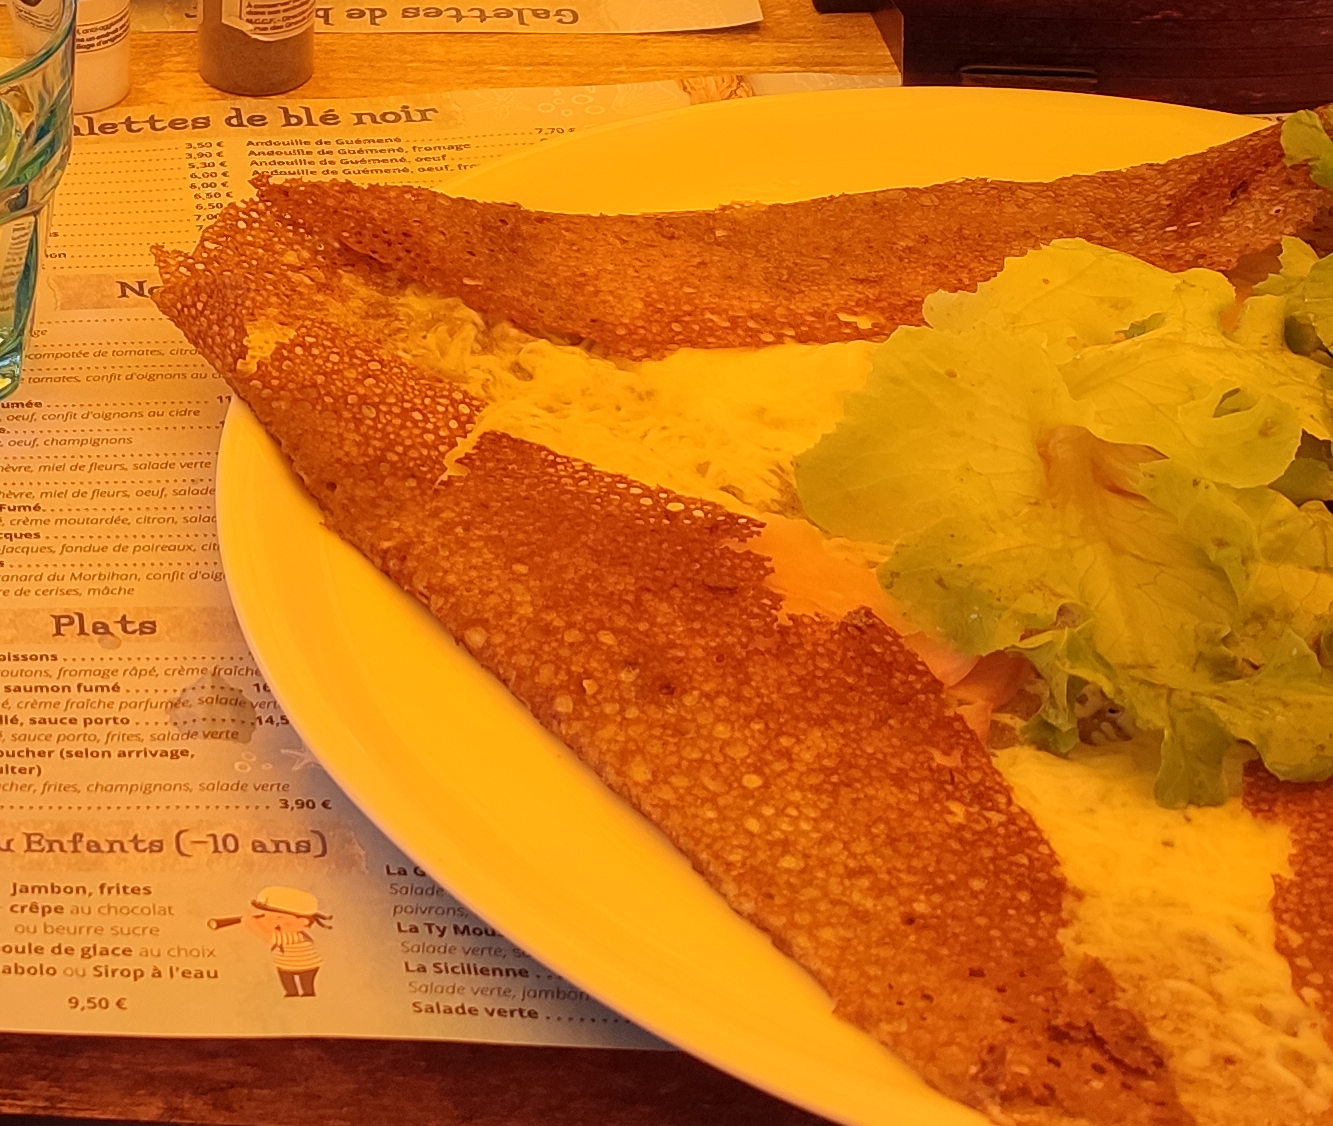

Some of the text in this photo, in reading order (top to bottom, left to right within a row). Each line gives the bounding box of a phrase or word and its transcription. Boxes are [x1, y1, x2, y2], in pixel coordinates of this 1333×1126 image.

[400, 6, 580, 26] Galettes
[74, 104, 439, 137] lettes de blé noir
[246, 139, 311, 147] Andouille
[8, 437, 39, 448] oeuf,
[44, 435, 133, 447] champignons
[38, 462, 65, 472] miel
[69, 462, 85, 472] de
[89, 461, 127, 473] fleurs,
[133, 460, 175, 470] salade
[179, 459, 211, 470] verte
[50, 611, 158, 636] Plats
[4, 683, 72, 694] saumon
[77, 681, 121, 694] fumé
[30, 715, 78, 726] sauce
[83, 714, 130, 729] porto
[59, 746, 112, 760] (selon
[118, 746, 194, 760] arrivage,
[279, 798, 316, 811] 3,90
[321, 799, 332, 809] €
[23, 831, 164, 854] Enfants
[251, 830, 328, 858] ans)
[10, 882, 152, 897] Jambon, frites
[10, 901, 174, 918] crêpe au chocolat
[393, 904, 468, 918] poivrons,
[14, 923, 160, 936] ou beurre sucre
[51, 942, 75, 956] de
[81, 943, 133, 959] glace
[139, 946, 161, 958] au
[167, 944, 216, 959] choix
[63, 966, 86, 978] ou
[92, 965, 144, 982] Sirop
[151, 965, 162, 979] à
[169, 966, 219, 980] l'eau
[405, 961, 529, 978] La Sicilienne
[67, 997, 128, 1011] 9,50 €
[412, 1002, 539, 1019] Salade verte
